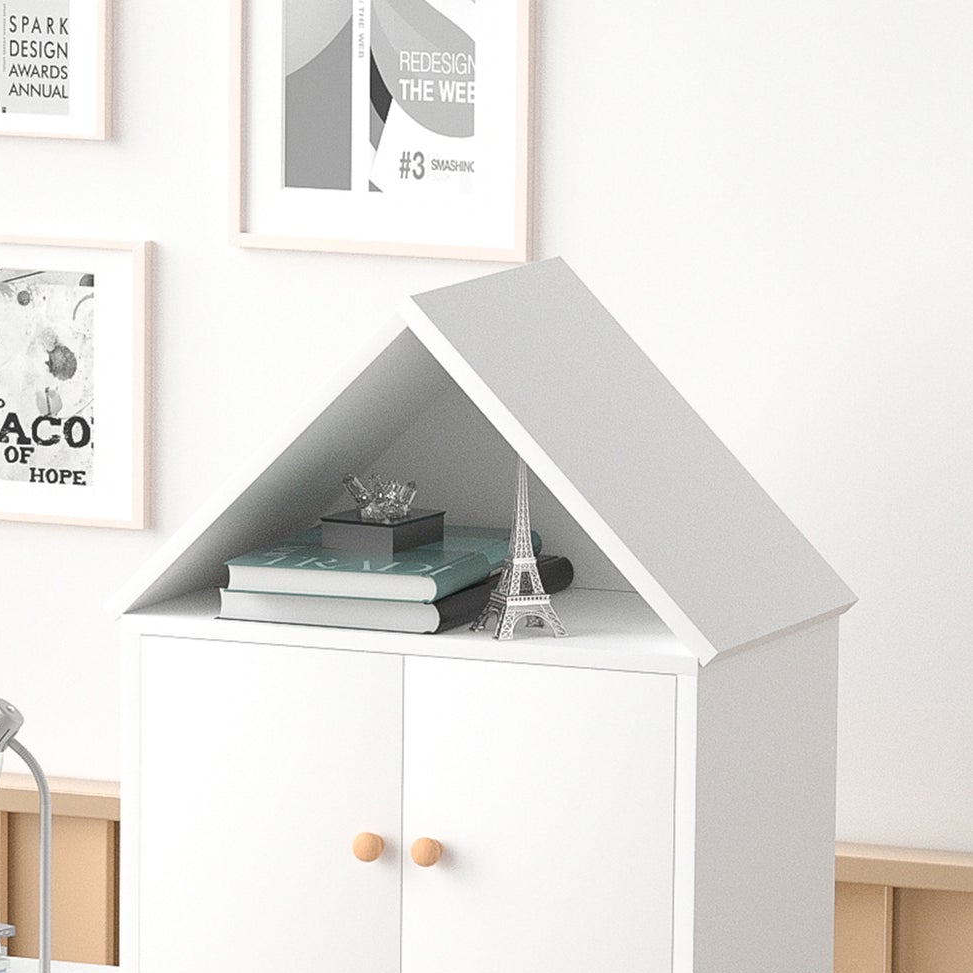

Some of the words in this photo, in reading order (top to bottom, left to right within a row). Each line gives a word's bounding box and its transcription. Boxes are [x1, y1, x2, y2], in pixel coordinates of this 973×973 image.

[9, 15, 69, 35] SPARK
[10, 40, 68, 59] DESIGN
[8, 64, 68, 80] AWARDS
[399, 51, 475, 75] REDESIGN
[8, 83, 69, 99] ANNUAL
[399, 79, 434, 101] THE
[399, 151, 425, 180] #3
[4, 445, 35, 464] OF
[30, 467, 87, 486] HOPE
